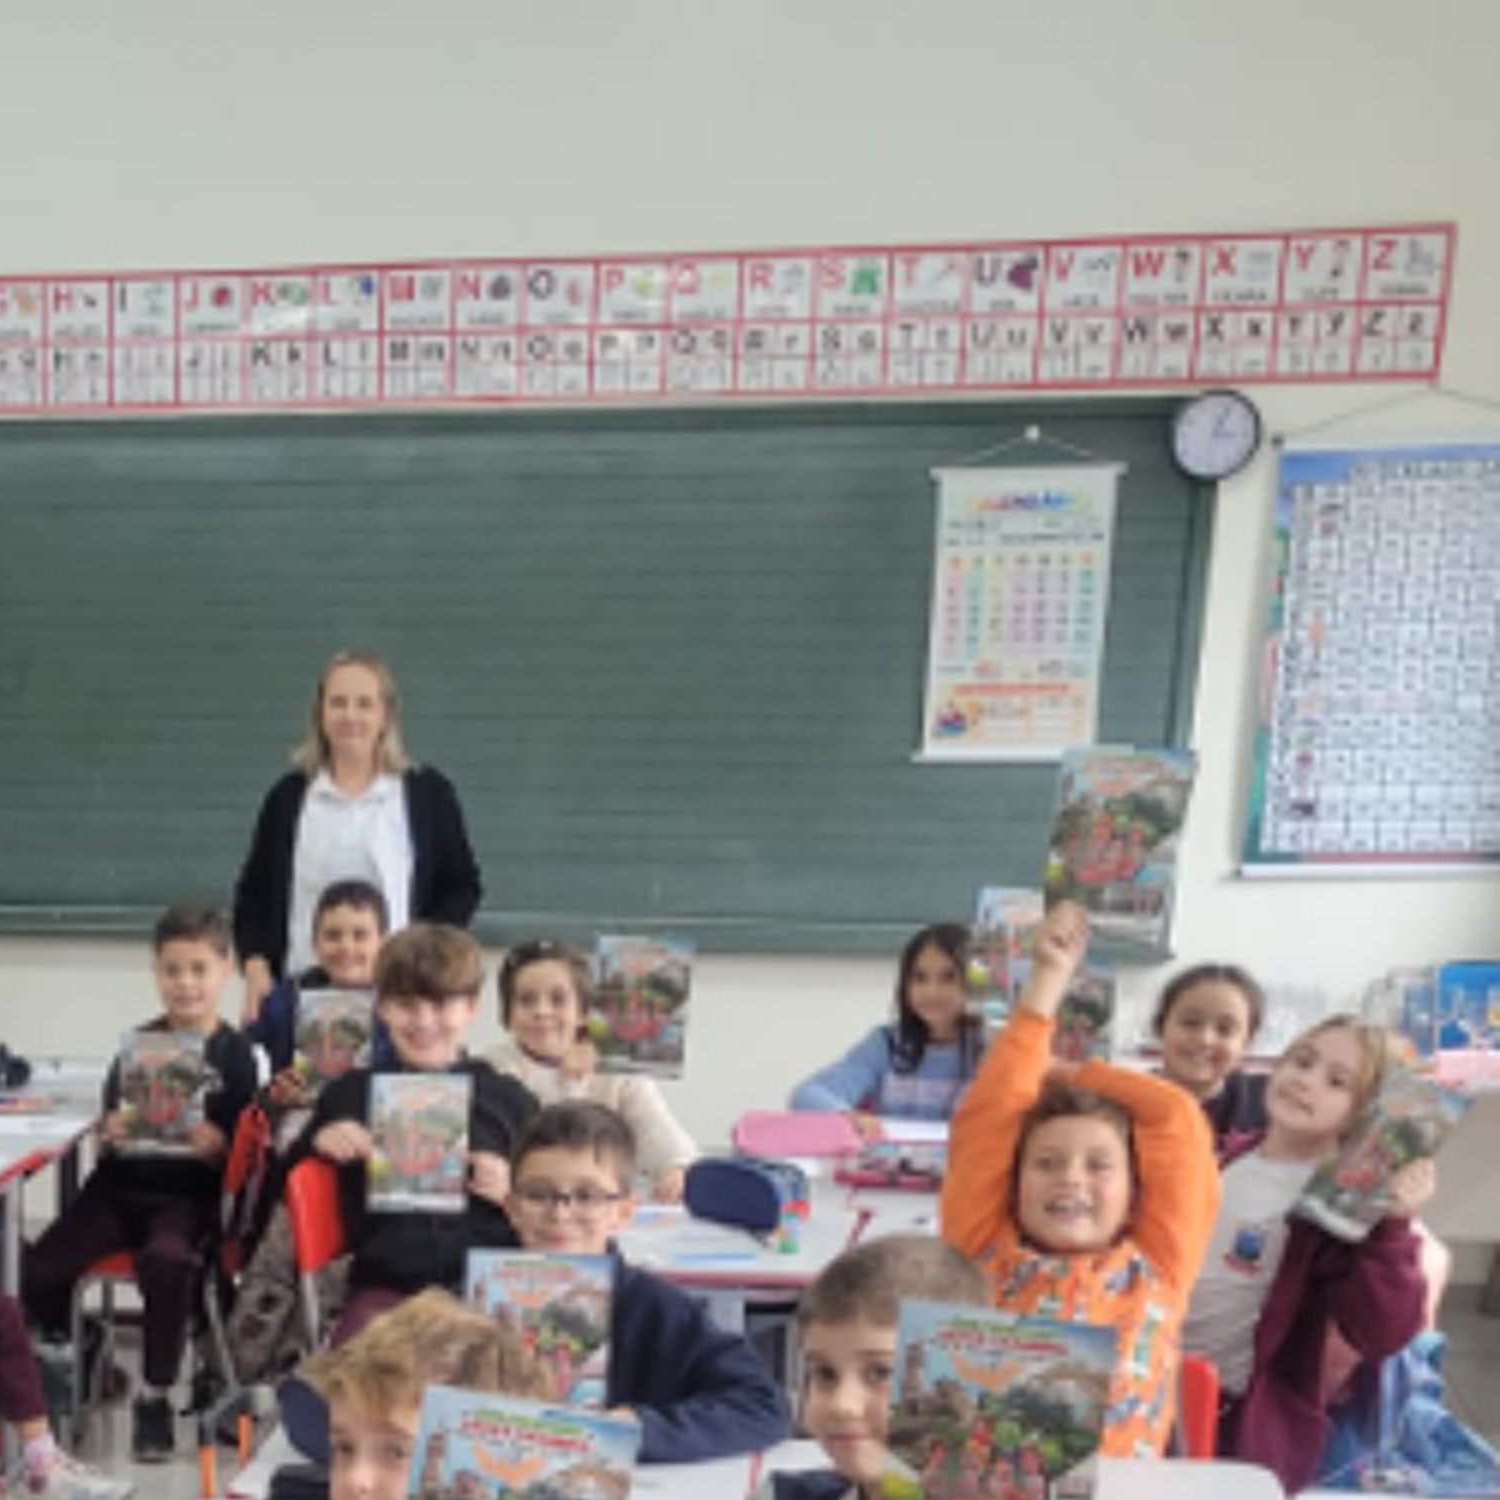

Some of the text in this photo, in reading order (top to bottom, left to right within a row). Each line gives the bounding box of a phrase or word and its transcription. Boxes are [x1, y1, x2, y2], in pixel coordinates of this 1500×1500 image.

[975, 255, 998, 285] U
[1055, 250, 1075, 282] V
[1133, 251, 1166, 279] W
[1211, 245, 1237, 277] X
[1295, 243, 1316, 271] Y
[1373, 239, 1398, 271] Z
[527, 269, 553, 299] O
[605, 267, 624, 294] P
[672, 262, 697, 294] Q
[750, 262, 774, 291] R
[822, 259, 846, 289] S
[900, 254, 919, 288] T
[53, 284, 73, 314] H
[252, 282, 275, 306] K
[389, 274, 415, 300] M
[459, 274, 481, 300] N
